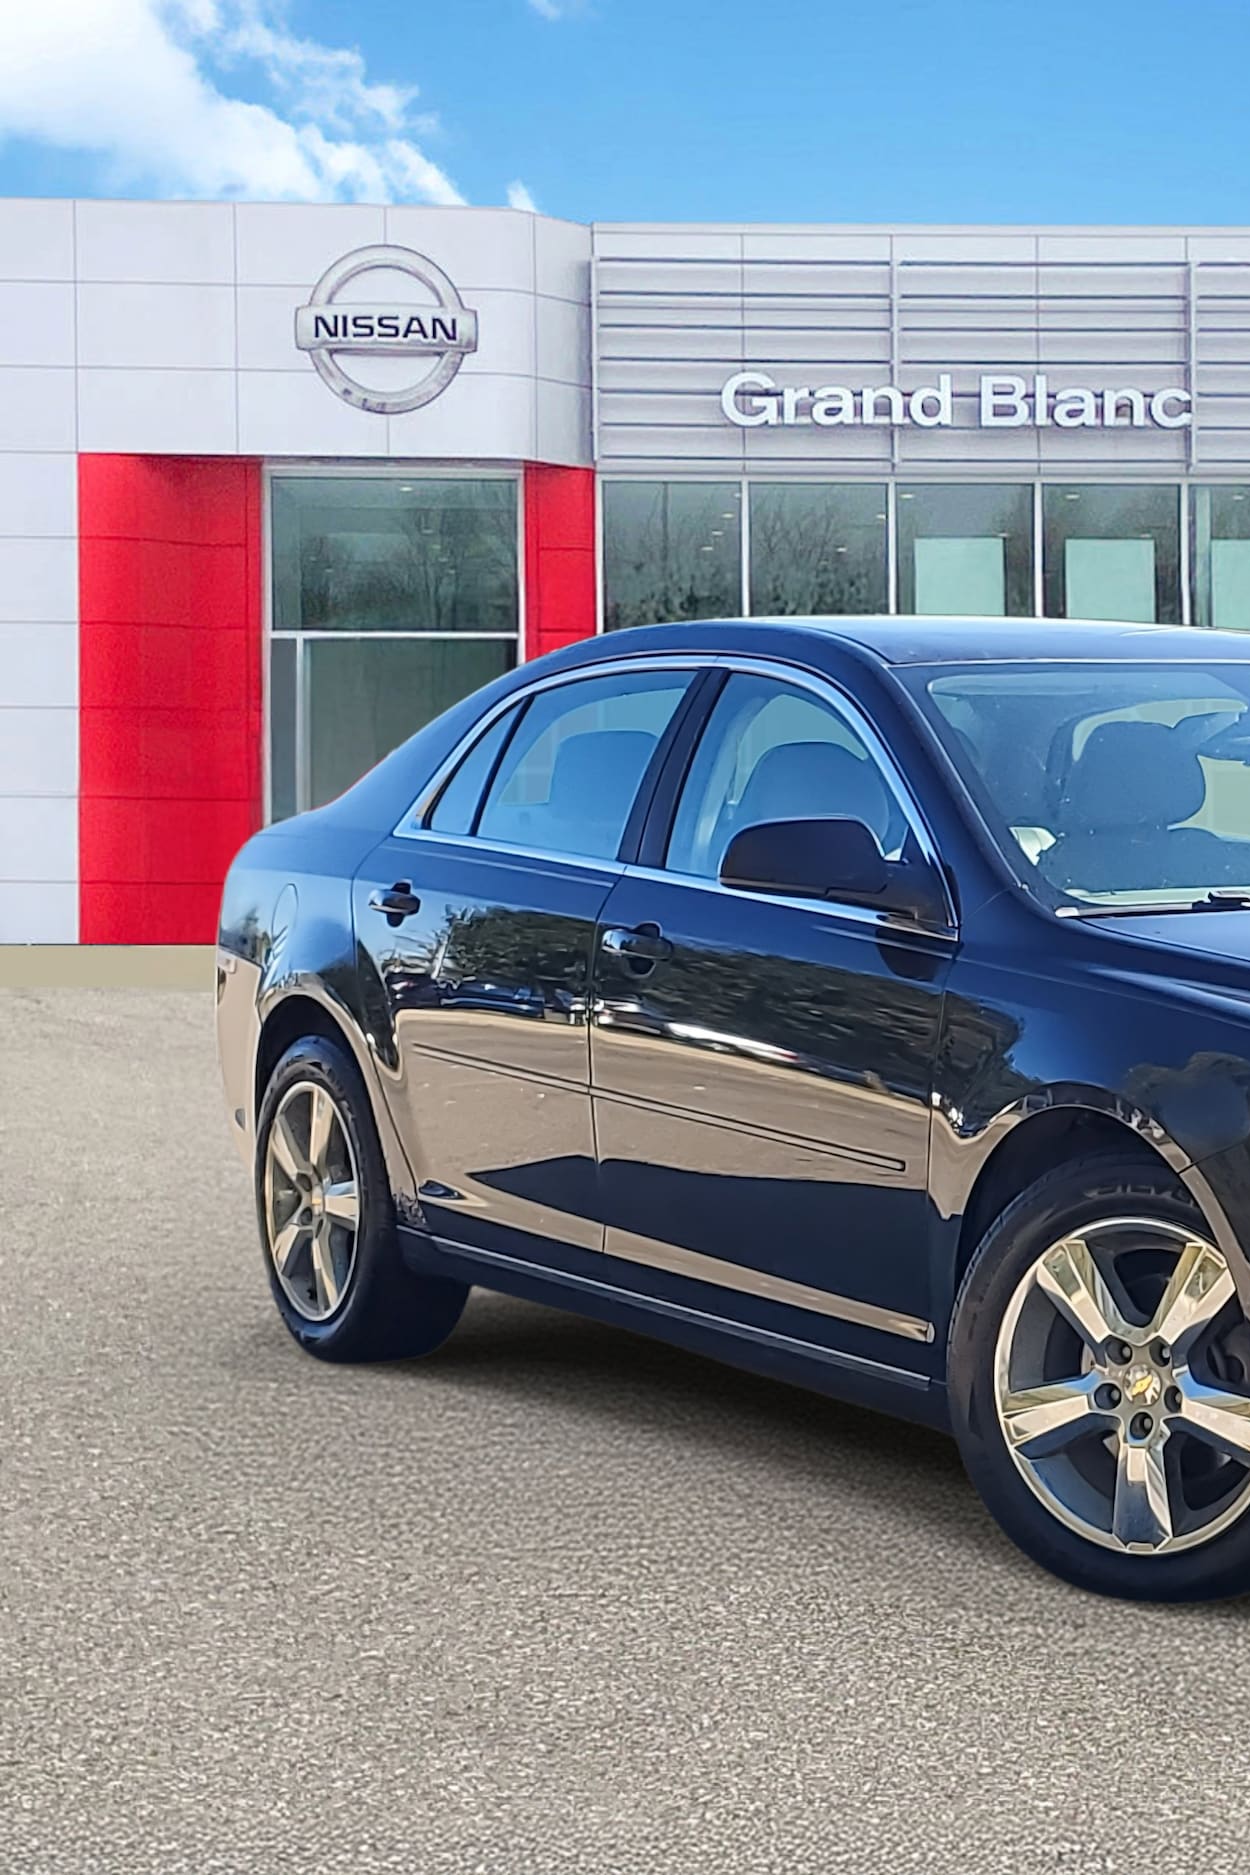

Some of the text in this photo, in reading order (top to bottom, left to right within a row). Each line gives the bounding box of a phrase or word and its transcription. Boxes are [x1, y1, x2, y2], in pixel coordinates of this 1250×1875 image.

[314, 314, 457, 341] NISSAN
[721, 371, 1193, 427] Grand Blanc
